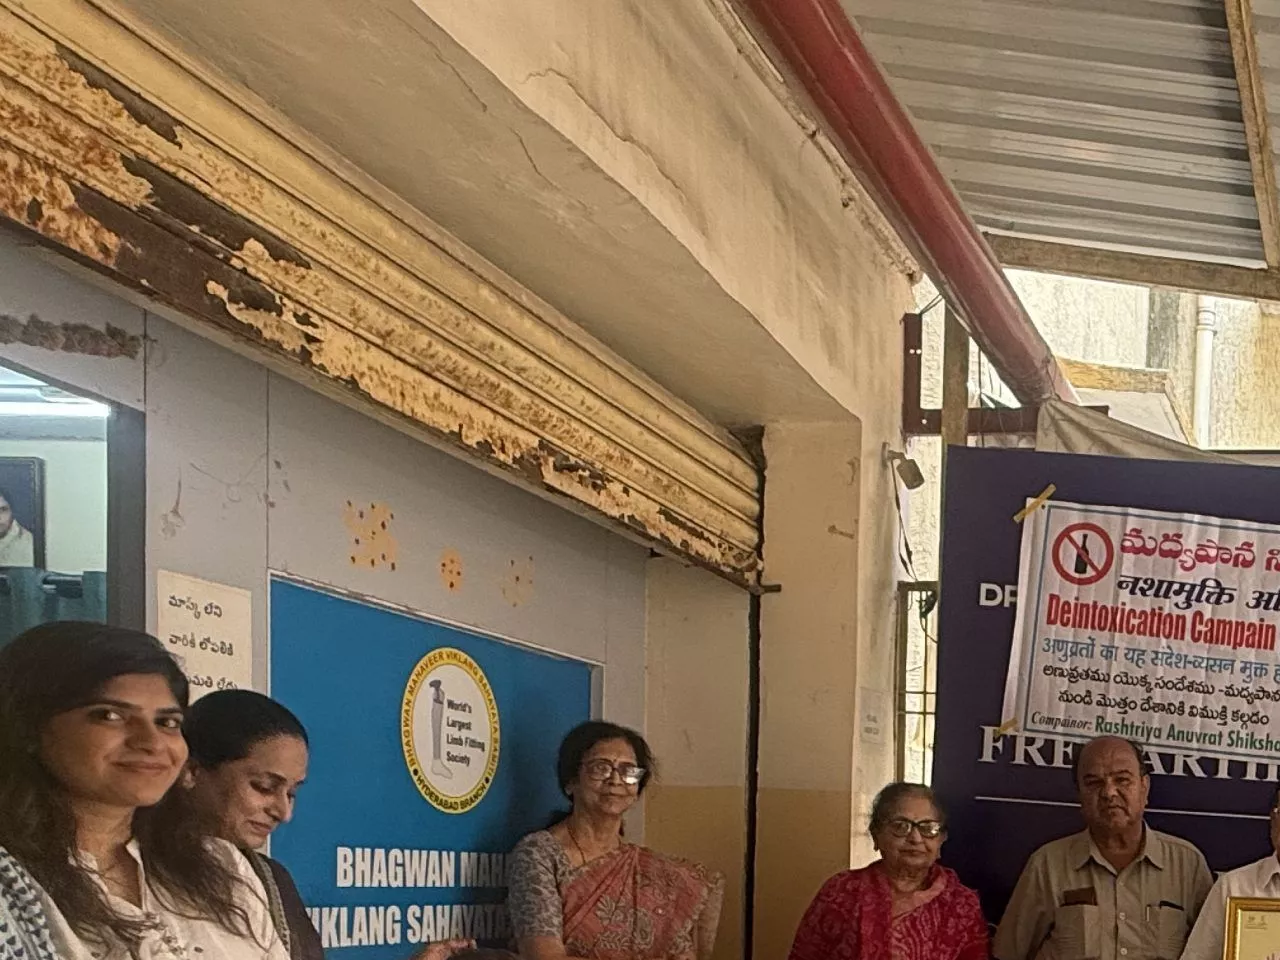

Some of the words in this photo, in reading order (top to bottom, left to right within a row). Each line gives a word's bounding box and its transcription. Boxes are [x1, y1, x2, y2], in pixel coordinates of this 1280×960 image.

[1120, 527, 1255, 571] మద్యపాన
[1117, 574, 1238, 610] नशामुक्ति
[1046, 593, 1187, 640] Deintoxication
[1190, 610, 1277, 650] Campain
[1100, 643, 1118, 661] का
[1124, 647, 1147, 669] यह
[1240, 660, 1268, 684] मुक्त
[1113, 670, 1153, 693] యొక్క
[1154, 675, 1215, 695] సందేశము
[446, 699, 472, 714] World's
[1058, 690, 1093, 705] నుండి
[1096, 693, 1137, 714] మొత్తం
[446, 716, 472, 731] Largest
[1095, 715, 1163, 744] Rashtriya
[1166, 723, 1224, 746] Anuvrat
[446, 733, 464, 747] Limb
[977, 725, 1074, 769] FRE
[446, 751, 471, 767] Society
[336, 846, 455, 888] BHAGWAN
[460, 851, 507, 888] MAH
